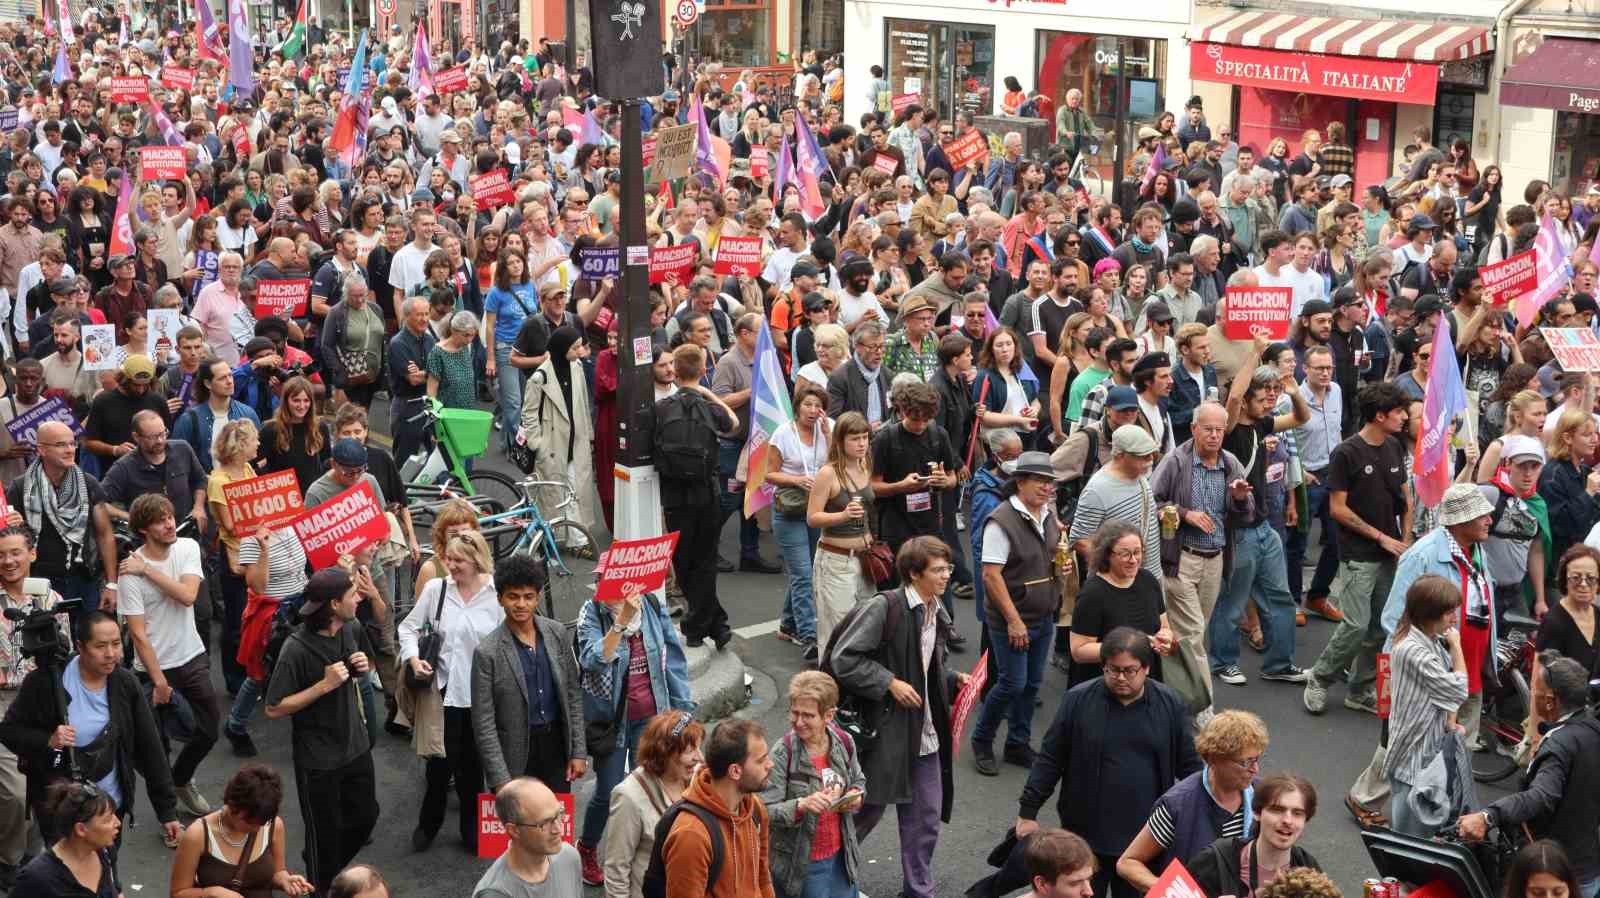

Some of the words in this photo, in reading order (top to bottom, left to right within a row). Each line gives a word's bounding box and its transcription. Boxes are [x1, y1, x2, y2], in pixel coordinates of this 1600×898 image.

[681, 5, 693, 16] 30
[1095, 50, 1118, 67] Orpi
[1215, 60, 1311, 84] SPECIALITÀ
[1322, 70, 1406, 93] ITALIANE
[1568, 92, 1599, 111] Page
[583, 258, 604, 272] 60
[1482, 255, 1535, 285] MACRON,
[259, 284, 307, 296] MACRON,
[1229, 292, 1290, 309] MACRON,
[225, 484, 252, 500] POUR
[253, 480, 266, 493] LE
[266, 473, 295, 490] SMIC
[230, 500, 244, 523] À
[287, 490, 301, 508] €
[295, 489, 373, 540] MACRON,
[608, 540, 673, 566] MACRON,
